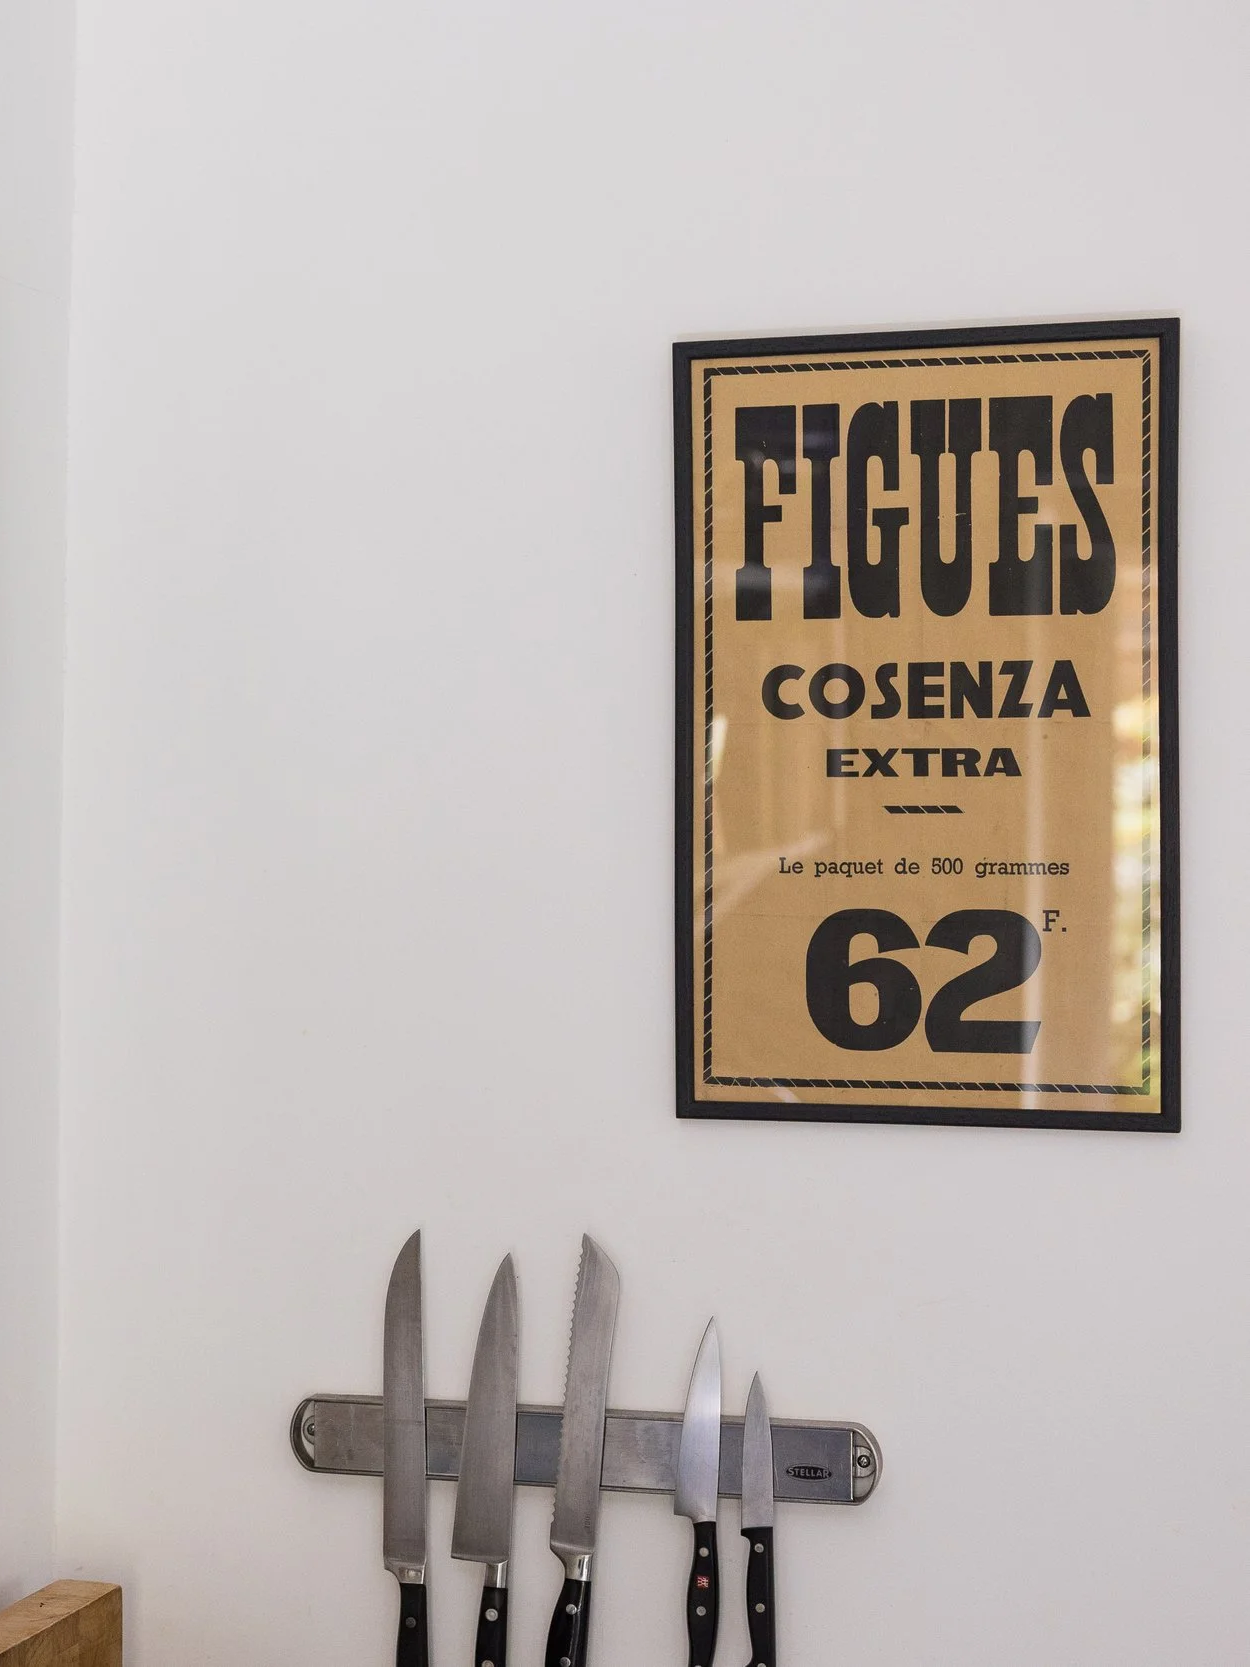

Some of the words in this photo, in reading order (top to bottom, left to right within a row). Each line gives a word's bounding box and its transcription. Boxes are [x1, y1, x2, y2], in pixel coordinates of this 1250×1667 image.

[734, 392, 1117, 622] FIGUES
[761, 659, 1092, 721] COSENZA
[826, 747, 1023, 778] EXTRA
[778, 857, 804, 876] Le
[813, 858, 884, 879] paquet
[893, 857, 921, 876] de
[931, 857, 964, 876] 500
[974, 860, 1070, 879] grammes
[805, 908, 1043, 1055] 62
[1042, 909, 1067, 933] F.
[788, 1467, 830, 1479] STELLAR
